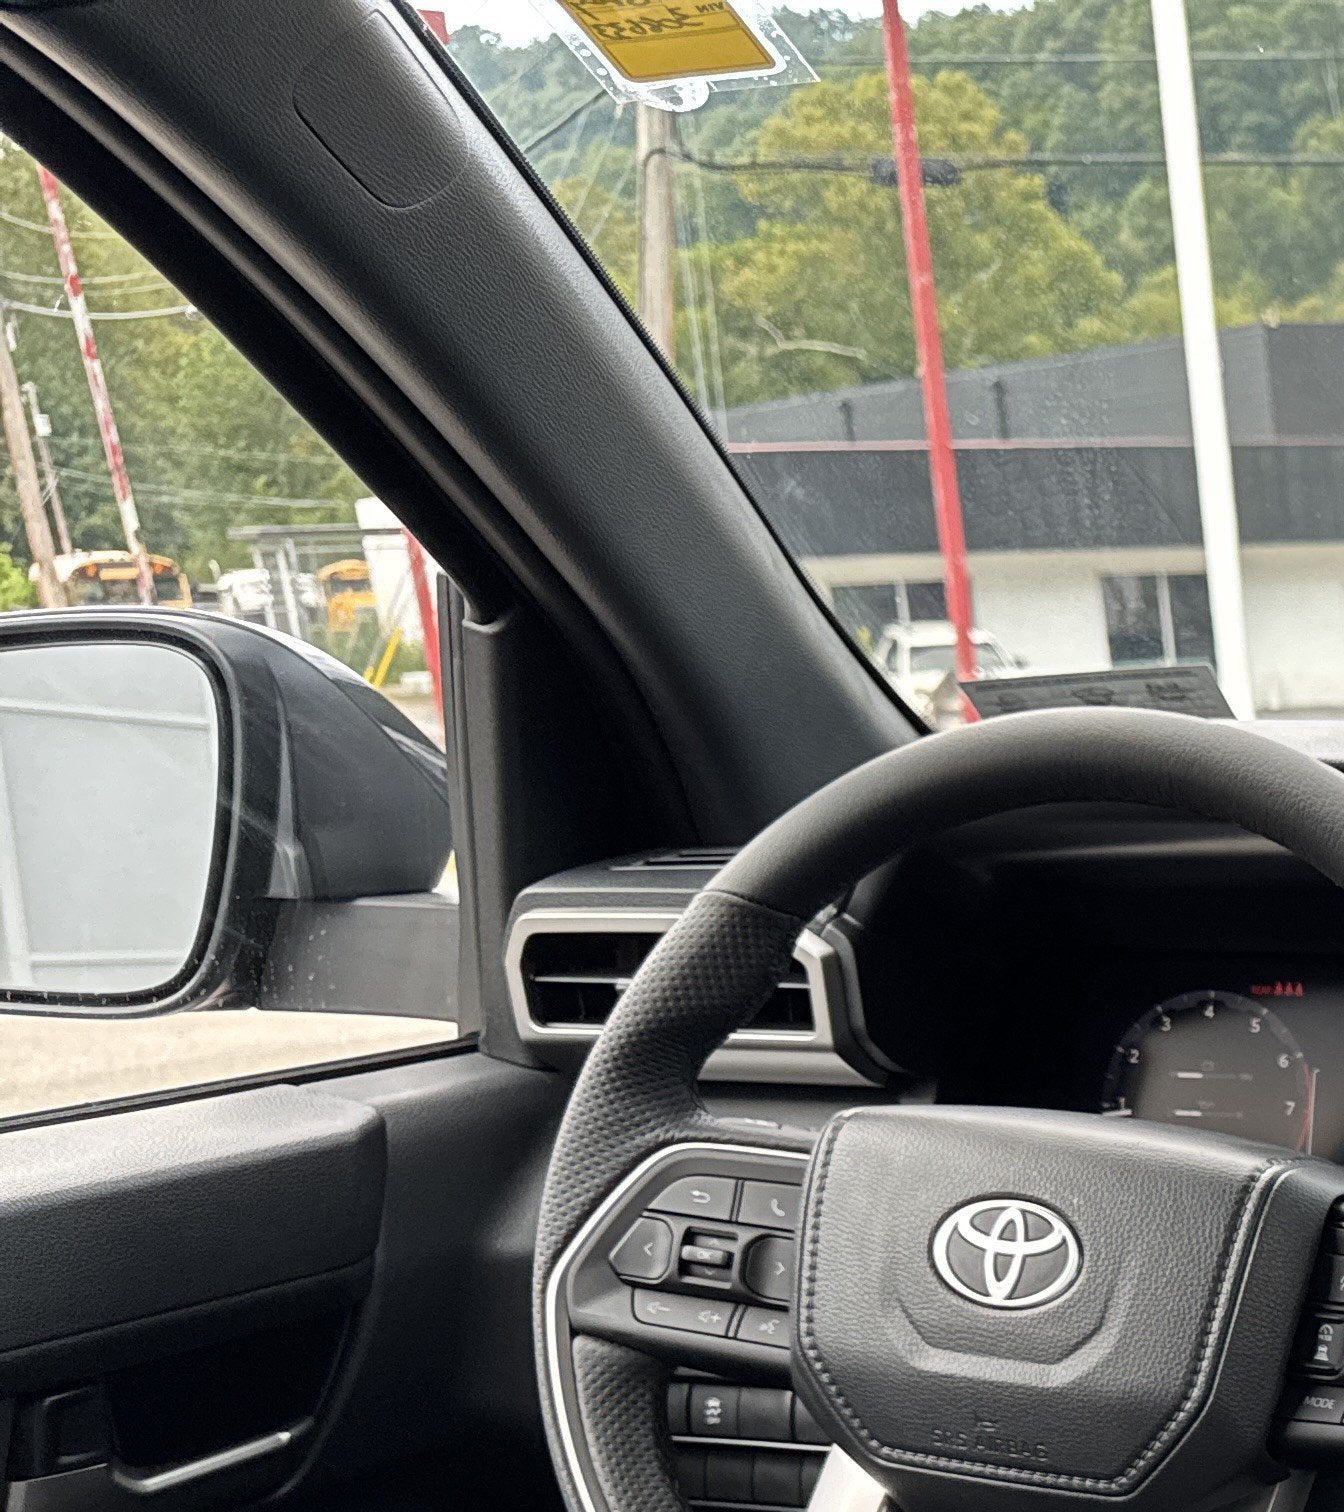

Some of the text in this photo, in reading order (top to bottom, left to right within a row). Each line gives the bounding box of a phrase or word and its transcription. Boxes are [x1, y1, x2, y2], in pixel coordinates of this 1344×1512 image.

[1204, 1005, 1215, 1019] 4
[1161, 1016, 1171, 1032] 3
[1250, 1017, 1261, 1034] 5
[1129, 1049, 1140, 1064] 2
[1277, 1053, 1290, 1068] 6
[1285, 1101, 1295, 1116] 7
[1305, 1396, 1335, 1409] MODE
